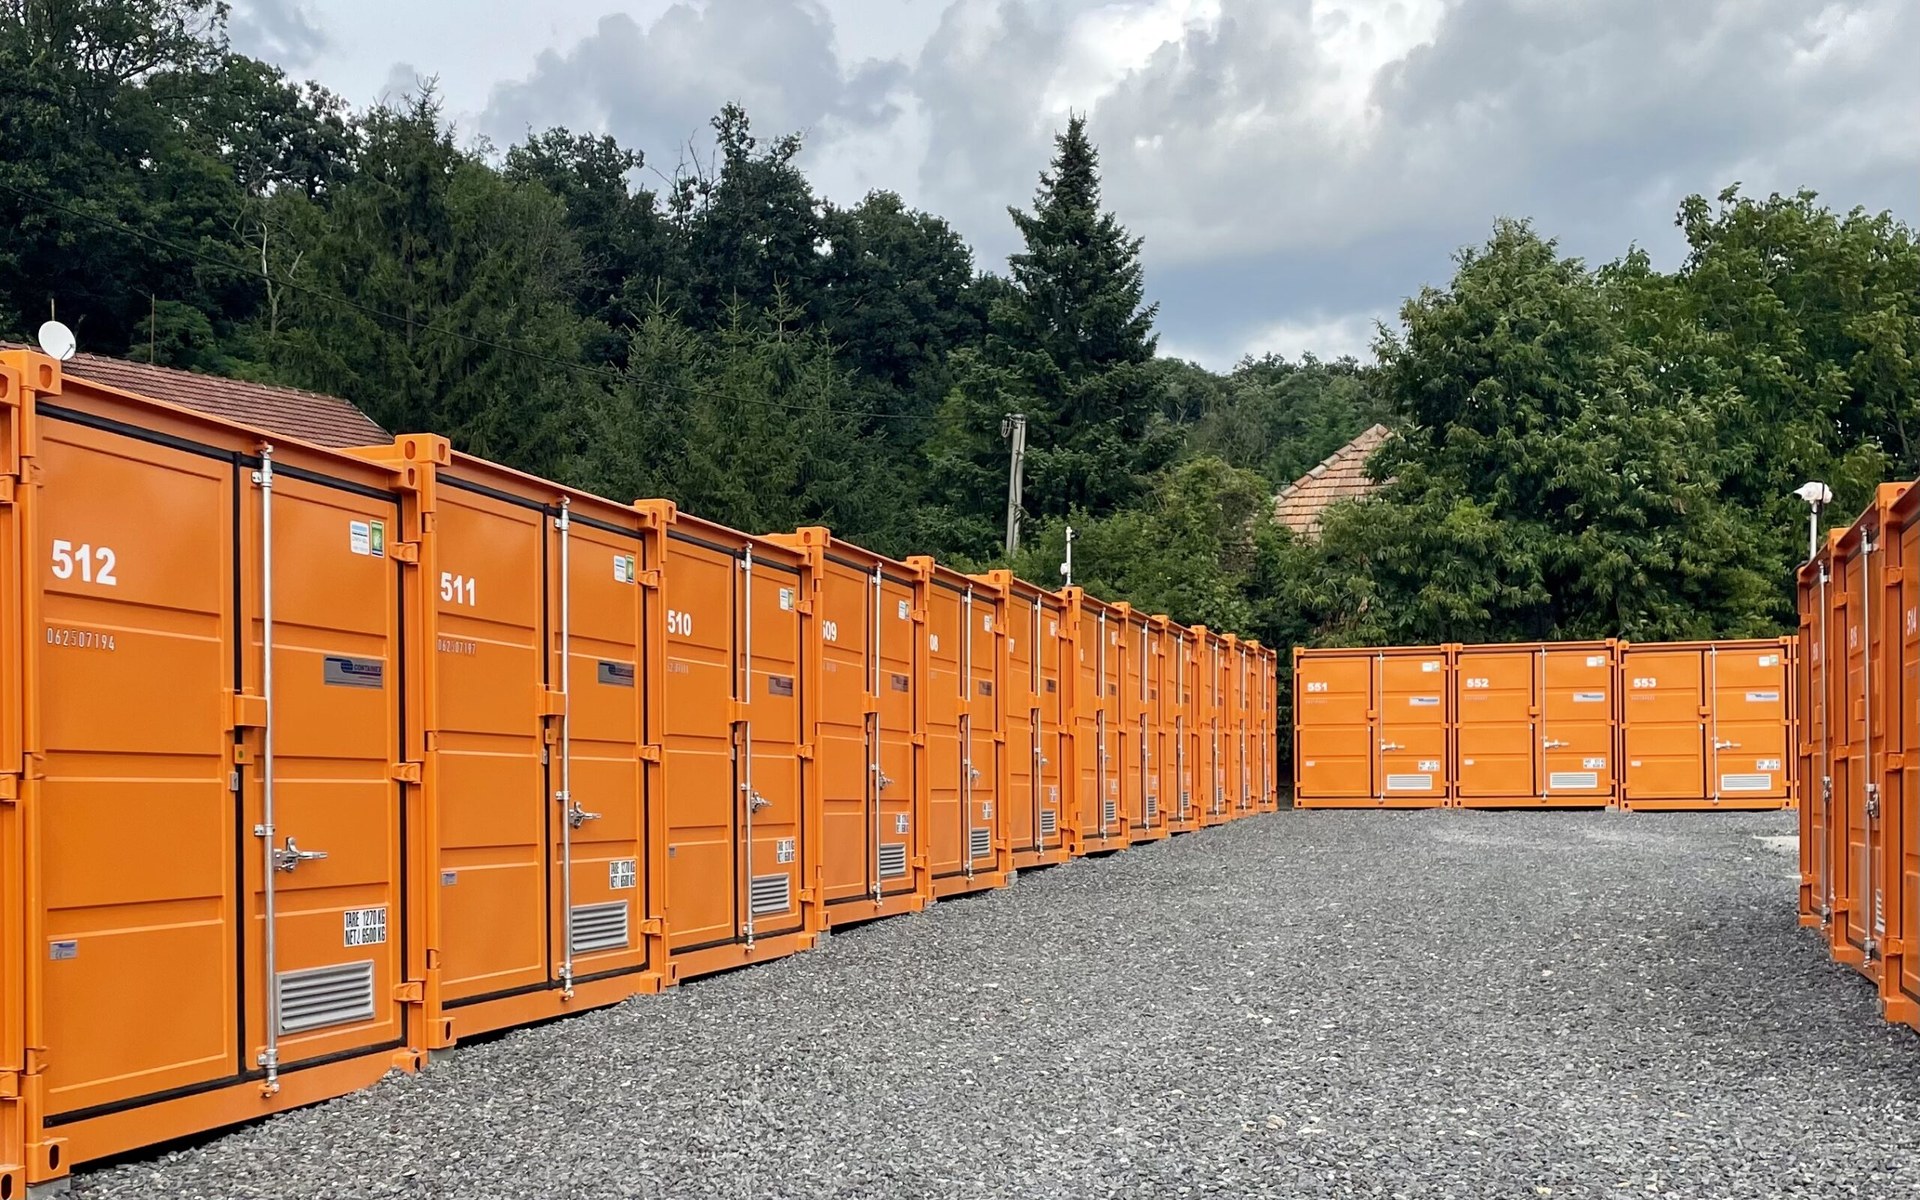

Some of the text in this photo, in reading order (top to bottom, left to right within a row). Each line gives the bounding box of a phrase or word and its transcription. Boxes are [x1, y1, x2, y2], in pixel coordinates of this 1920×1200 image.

[51, 539, 117, 586] 512
[440, 571, 475, 607] 511
[667, 609, 692, 637] 510
[1907, 606, 1917, 636] 514
[47, 627, 115, 651] 062507194
[929, 633, 939, 652] 08
[1307, 682, 1328, 692] 551
[1466, 678, 1489, 688] 552
[1633, 677, 1657, 688] 553
[345, 908, 386, 928] TARE 1270 KG
[362, 927, 377, 943] 6500
[378, 926, 386, 942] KG
